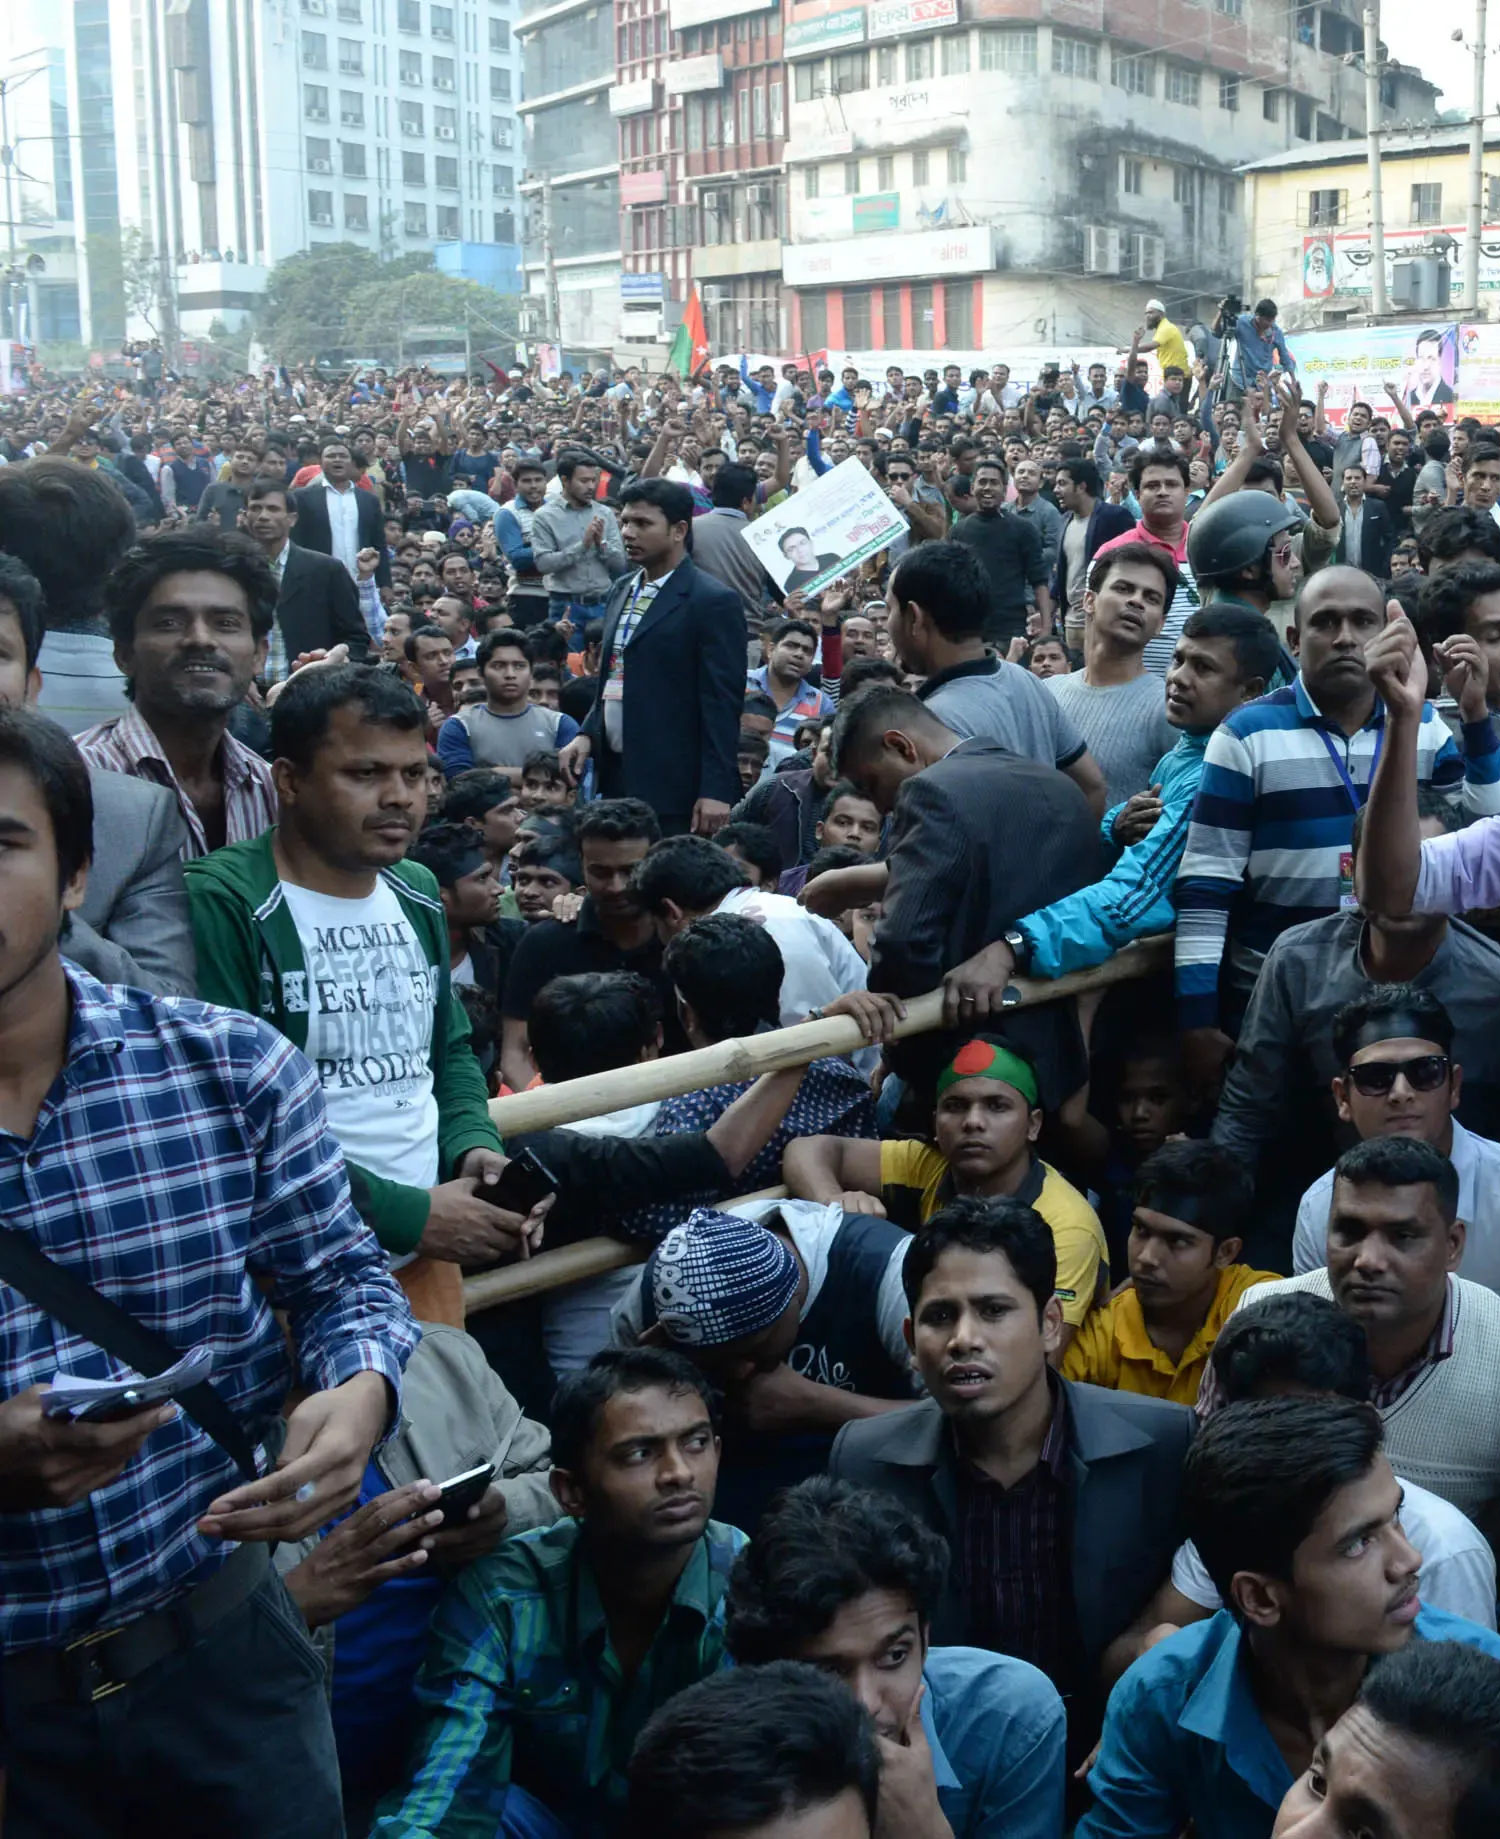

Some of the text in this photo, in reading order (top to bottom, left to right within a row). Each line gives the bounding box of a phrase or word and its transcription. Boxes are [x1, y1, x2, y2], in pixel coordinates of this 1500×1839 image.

[940, 243, 968, 261] airtel
[808, 258, 832, 272] airtel
[315, 979, 372, 1014] Est
